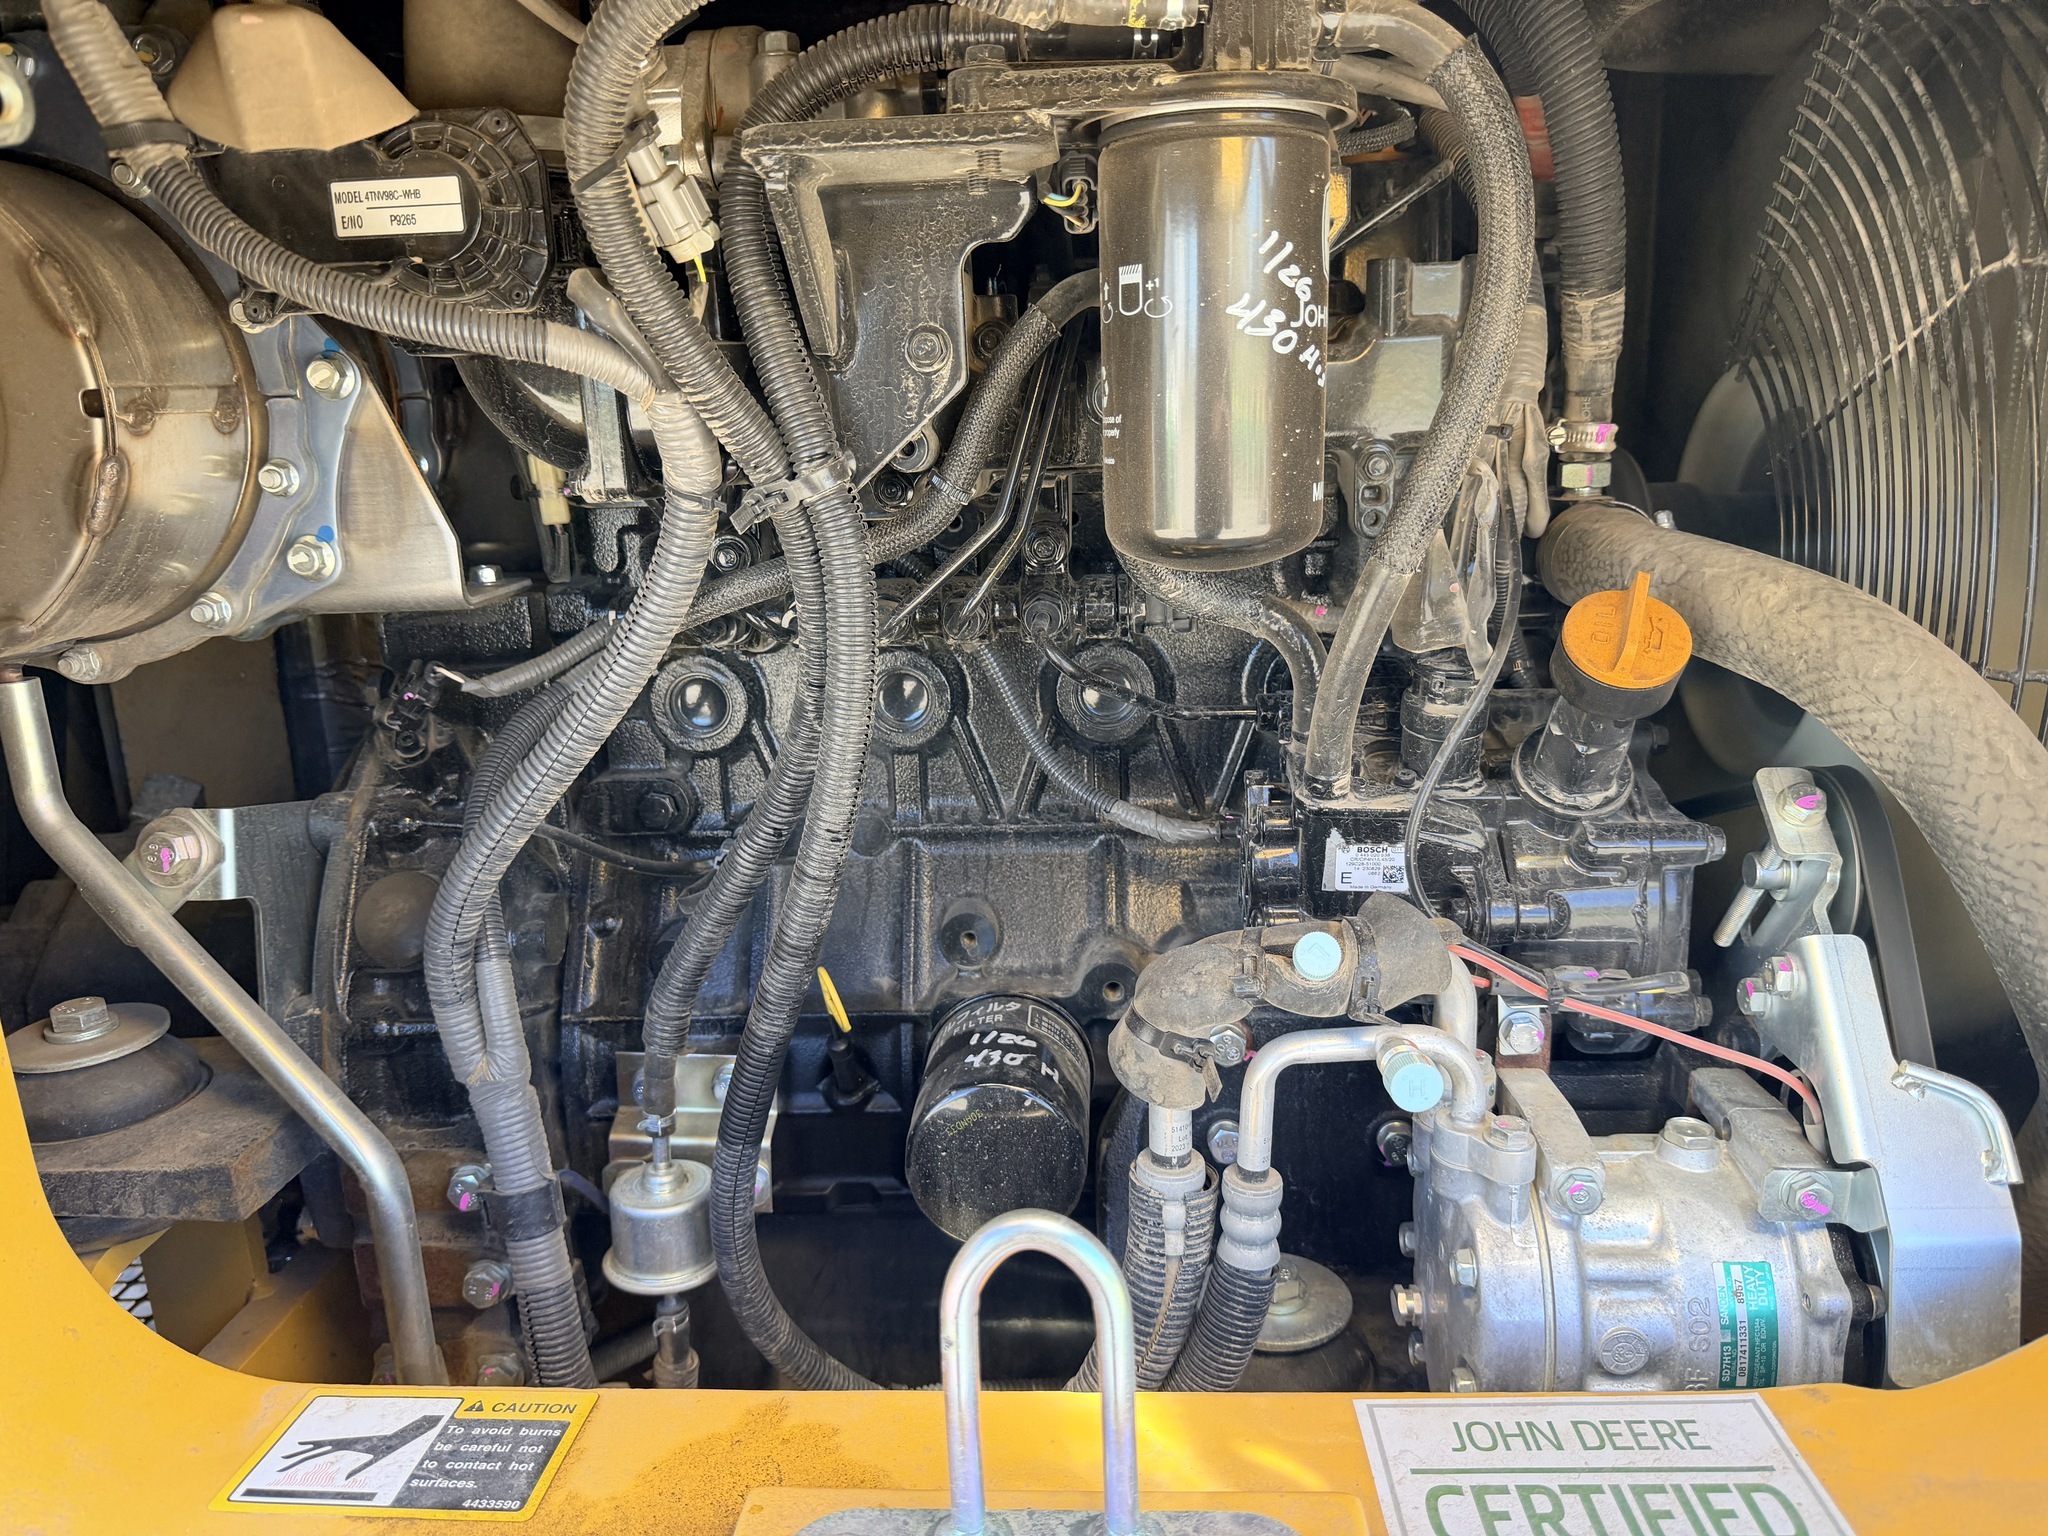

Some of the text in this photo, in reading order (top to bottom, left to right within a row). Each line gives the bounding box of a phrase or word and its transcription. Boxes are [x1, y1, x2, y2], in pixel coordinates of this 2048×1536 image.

[334, 188, 421, 205] MODEL 4TNV98C-WHB
[341, 214, 417, 229] E/NO P9265
[1225, 292, 1298, 354] 430
[1591, 606, 1616, 645] OIL
[1340, 872, 1352, 884] E
[953, 1014, 1003, 1036] FILTER
[1743, 1264, 1759, 1311] HEAVY
[1754, 1269, 1768, 1306] DUTY
[1718, 1285, 1730, 1325] SANDEN
[1738, 1320, 1747, 1378] 0817411331
[1721, 1345, 1731, 1382] SD7H13
[491, 1402, 578, 1414] CAUTION
[447, 1425, 562, 1436] To avoid burns
[1451, 1418, 1713, 1453] JOHN DEERE
[434, 1442, 544, 1453] be careful not
[422, 1460, 535, 1471] to contact hot
[409, 1478, 478, 1488] surfaces.
[462, 1499, 521, 1509] 4433590
[1424, 1481, 1813, 1536] CERTIFIED
